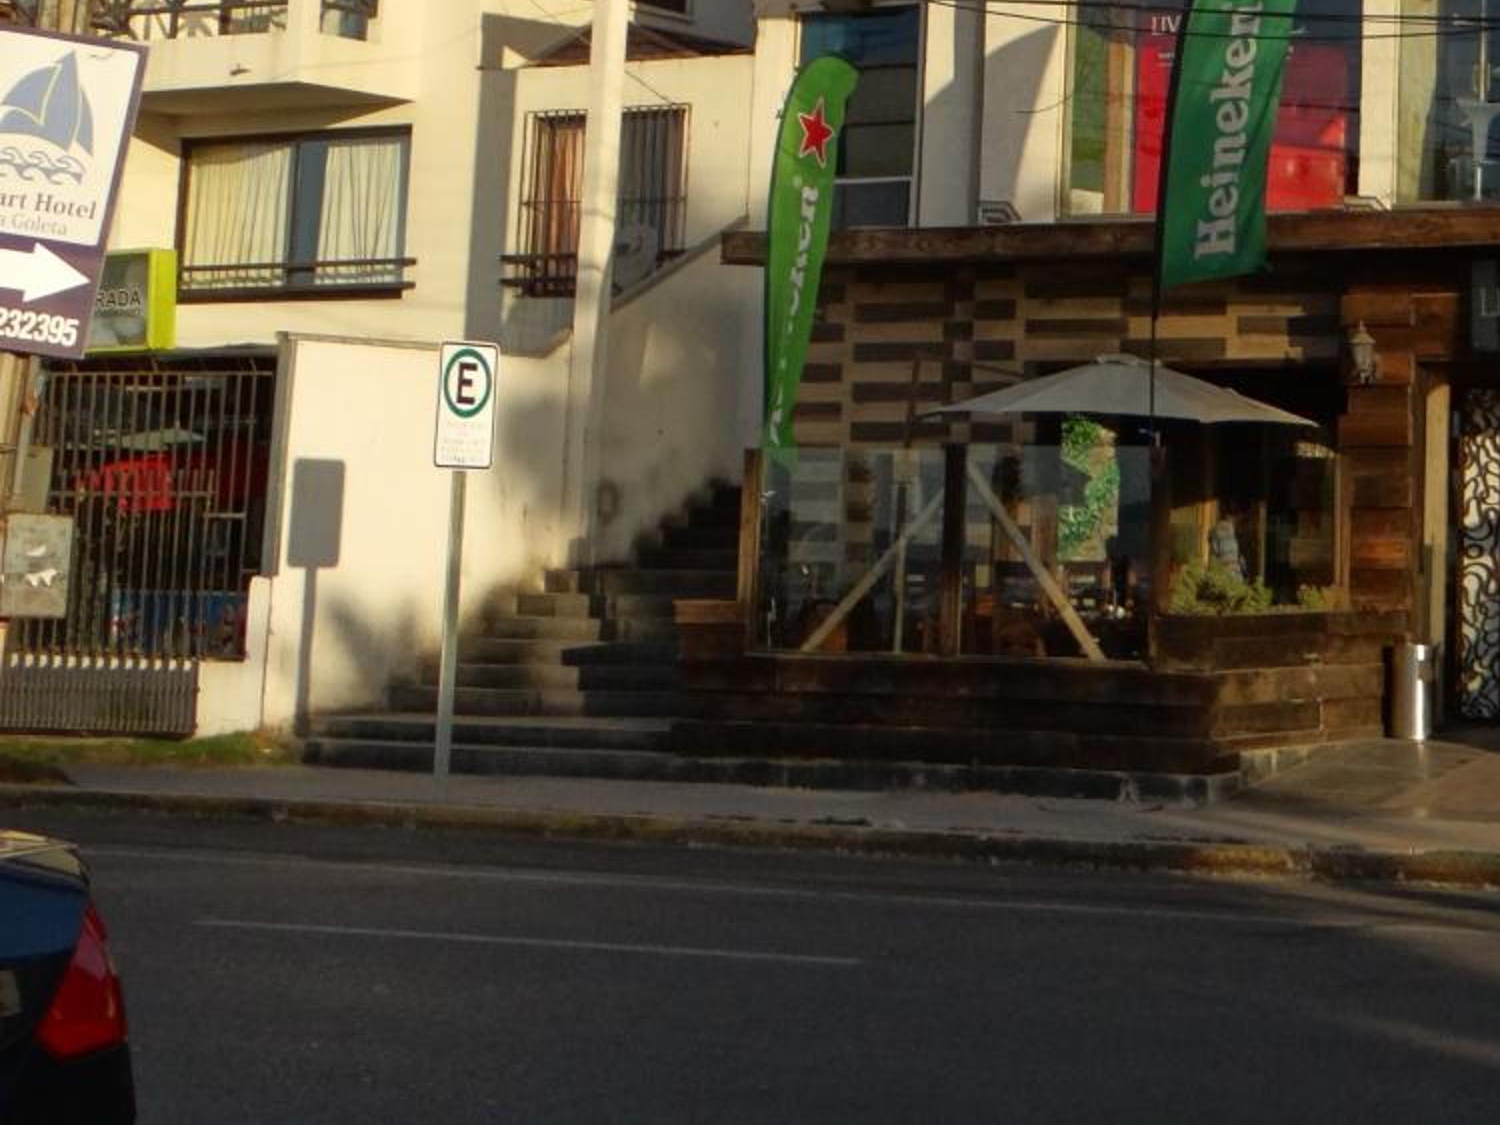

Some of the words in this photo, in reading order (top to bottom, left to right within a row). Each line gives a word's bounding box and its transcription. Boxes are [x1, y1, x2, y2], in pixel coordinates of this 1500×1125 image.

[1195, 2, 1264, 259] Heineken
[34, 192, 97, 220] Hotel
[0, 307, 80, 347] 232395
[456, 362, 478, 405] E
